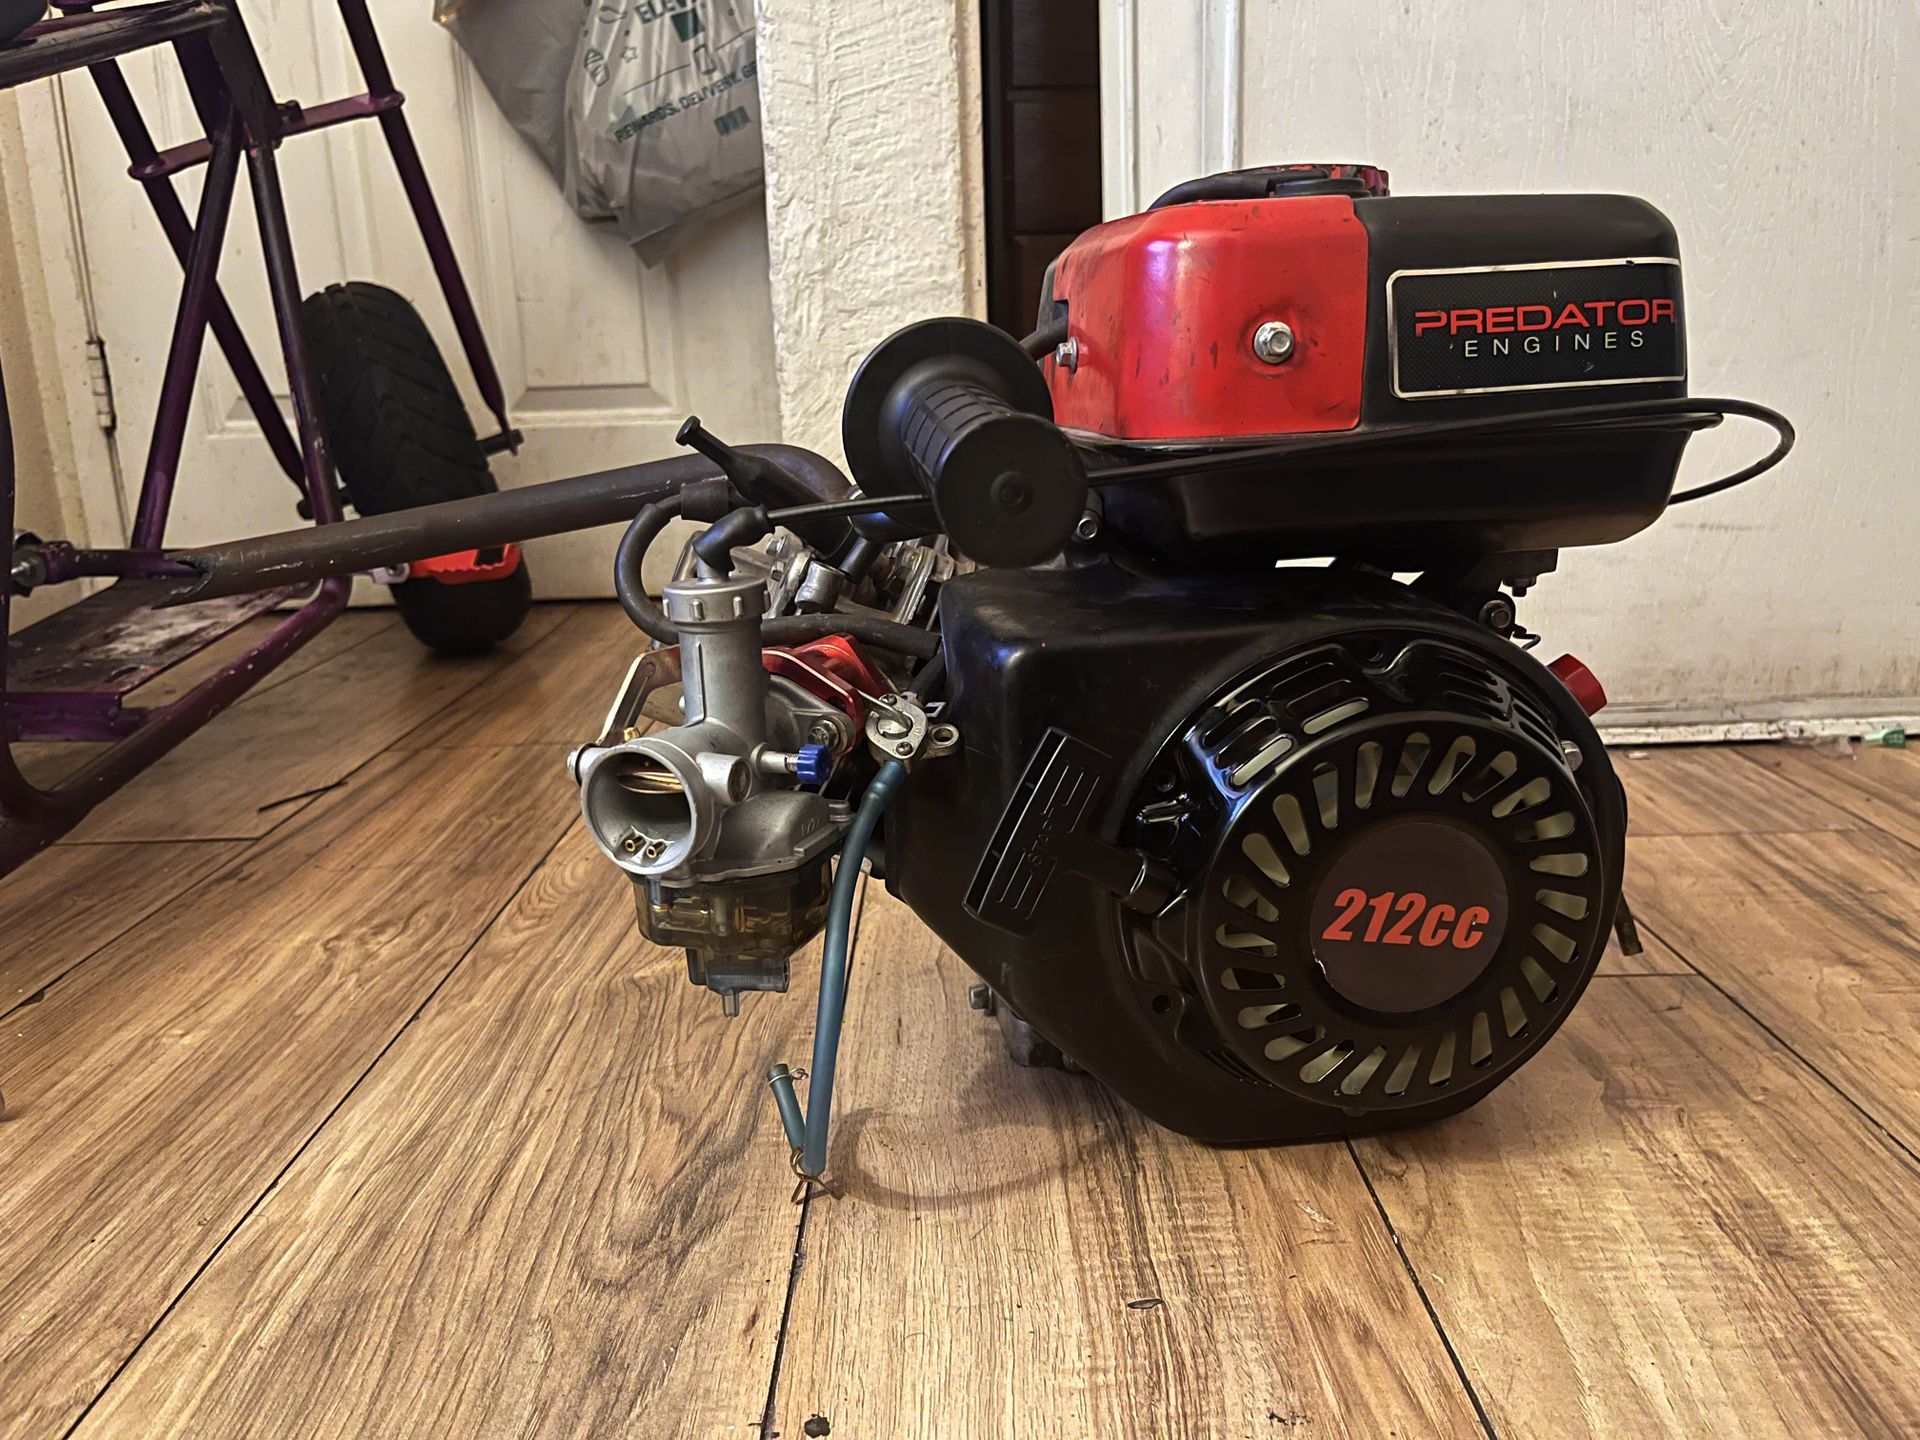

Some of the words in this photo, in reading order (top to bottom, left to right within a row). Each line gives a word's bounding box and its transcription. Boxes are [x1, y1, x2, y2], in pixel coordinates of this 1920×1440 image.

[1414, 298, 1676, 337] PREDATOR
[1464, 330, 1644, 357] ENGINES
[1321, 888, 1490, 949] 212cc
